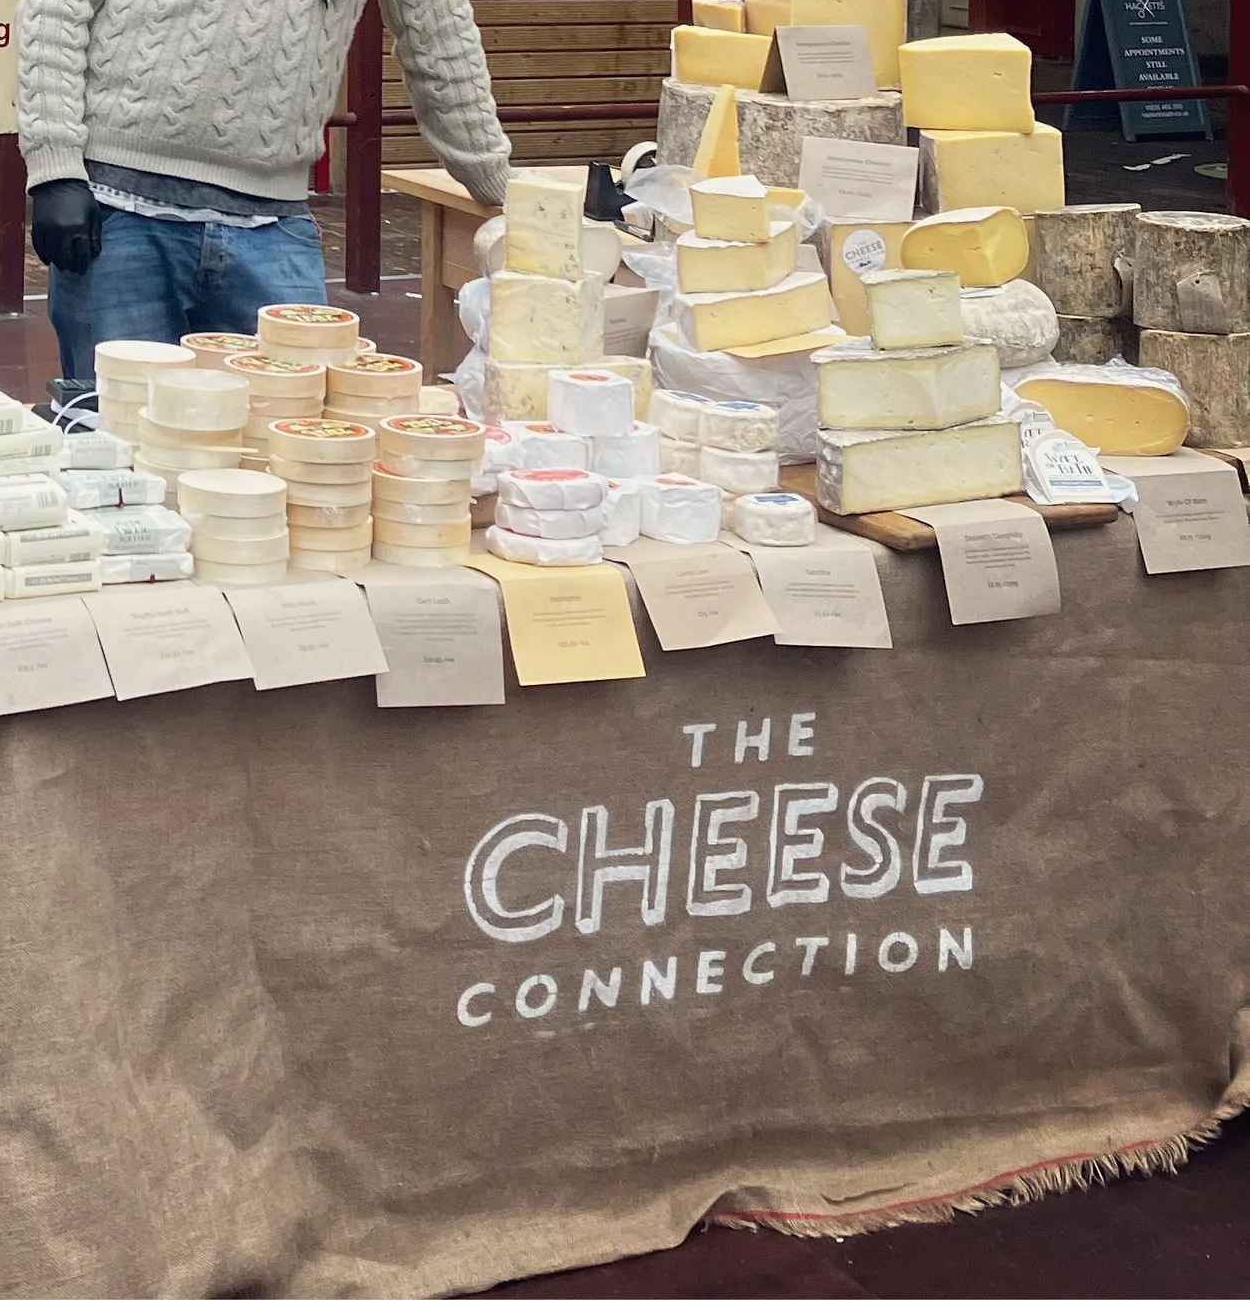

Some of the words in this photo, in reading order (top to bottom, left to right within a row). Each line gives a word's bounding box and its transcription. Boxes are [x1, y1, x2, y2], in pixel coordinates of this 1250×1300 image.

[1141, 35, 1164, 44] SOME
[1124, 48, 1185, 57] APPOINTMENTS
[1146, 61, 1168, 69] STILL
[1138, 73, 1180, 82] AVAILABLE
[845, 240, 883, 260] CHEESE
[683, 712, 817, 767] THE
[463, 774, 985, 942] CHEESE
[457, 926, 975, 1027] CONNECTION
